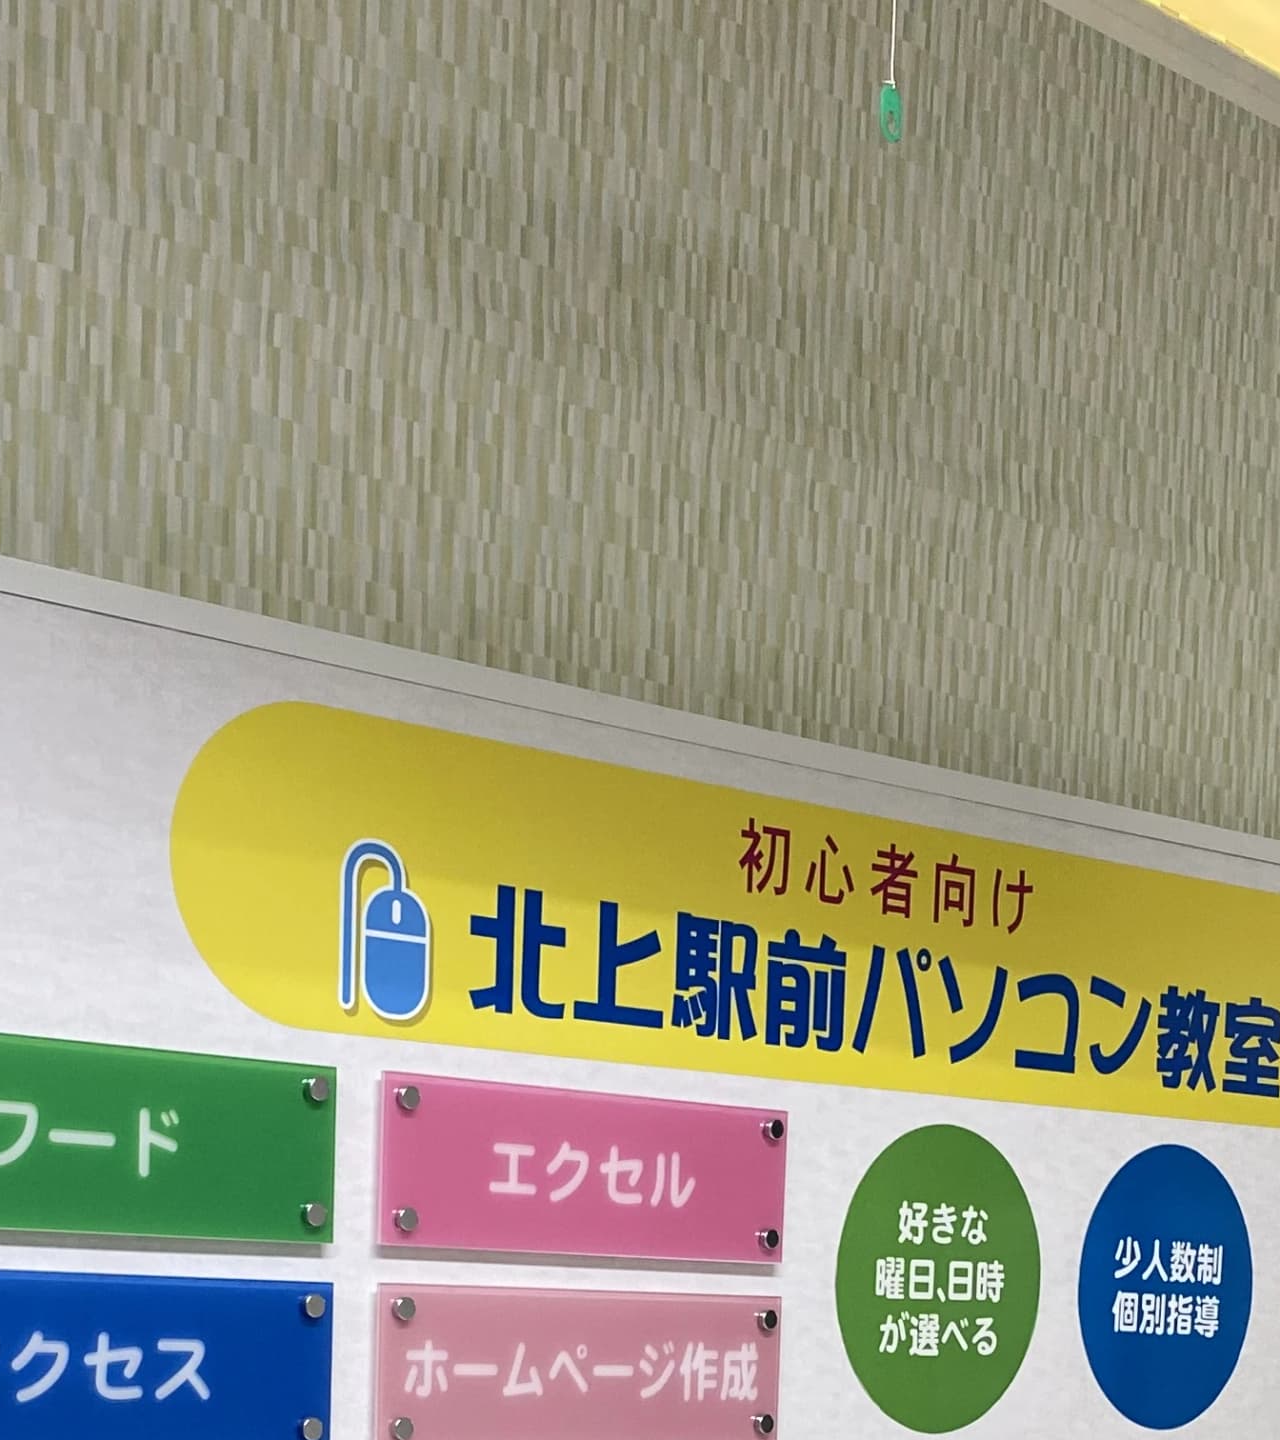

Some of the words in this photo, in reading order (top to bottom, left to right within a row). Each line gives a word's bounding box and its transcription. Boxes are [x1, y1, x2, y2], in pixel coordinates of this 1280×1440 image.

[738, 817, 1034, 935] 初心者向け
[489, 1141, 696, 1208] エクセル
[898, 1201, 989, 1245] 好きな
[1113, 1237, 1223, 1286] 少人数制
[879, 1314, 998, 1357] が選べる
[1111, 1291, 1219, 1339] 個別指導
[404, 1340, 759, 1402] ホームページ作成
